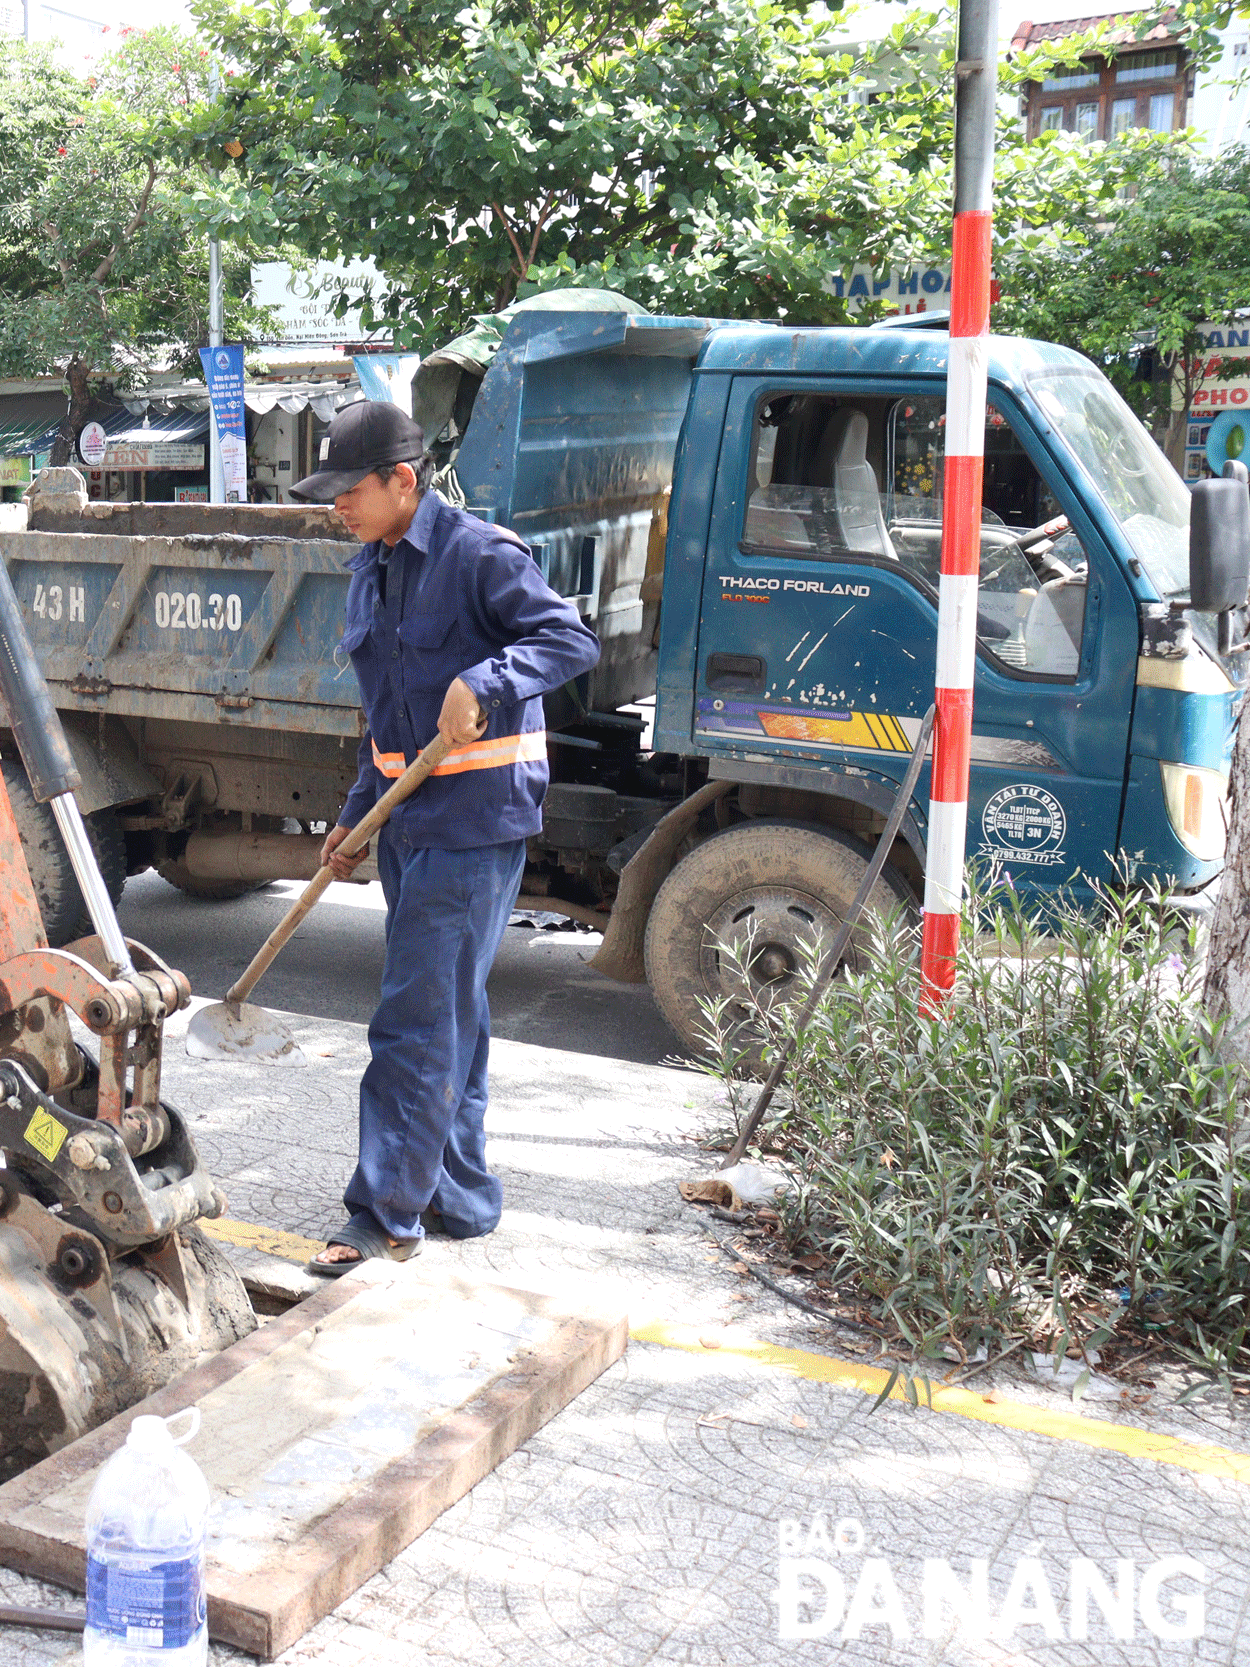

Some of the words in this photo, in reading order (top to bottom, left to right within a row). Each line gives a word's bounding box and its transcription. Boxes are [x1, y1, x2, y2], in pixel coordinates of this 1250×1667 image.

[898, 269, 951, 295] HO
[719, 576, 780, 590] THACO
[783, 580, 870, 597] FORLAND
[33, 584, 63, 621] 43
[69, 586, 85, 623] H
[155, 591, 242, 631] 020.30
[997, 812, 1015, 821] 3270
[1014, 814, 1023, 822] KG
[1026, 807, 1041, 816] TTCP
[1041, 794, 1062, 839] DOANH
[1025, 815, 1043, 823] 2000
[1026, 827, 1042, 839] 3N
[993, 849, 1050, 863] 0799.432.777
